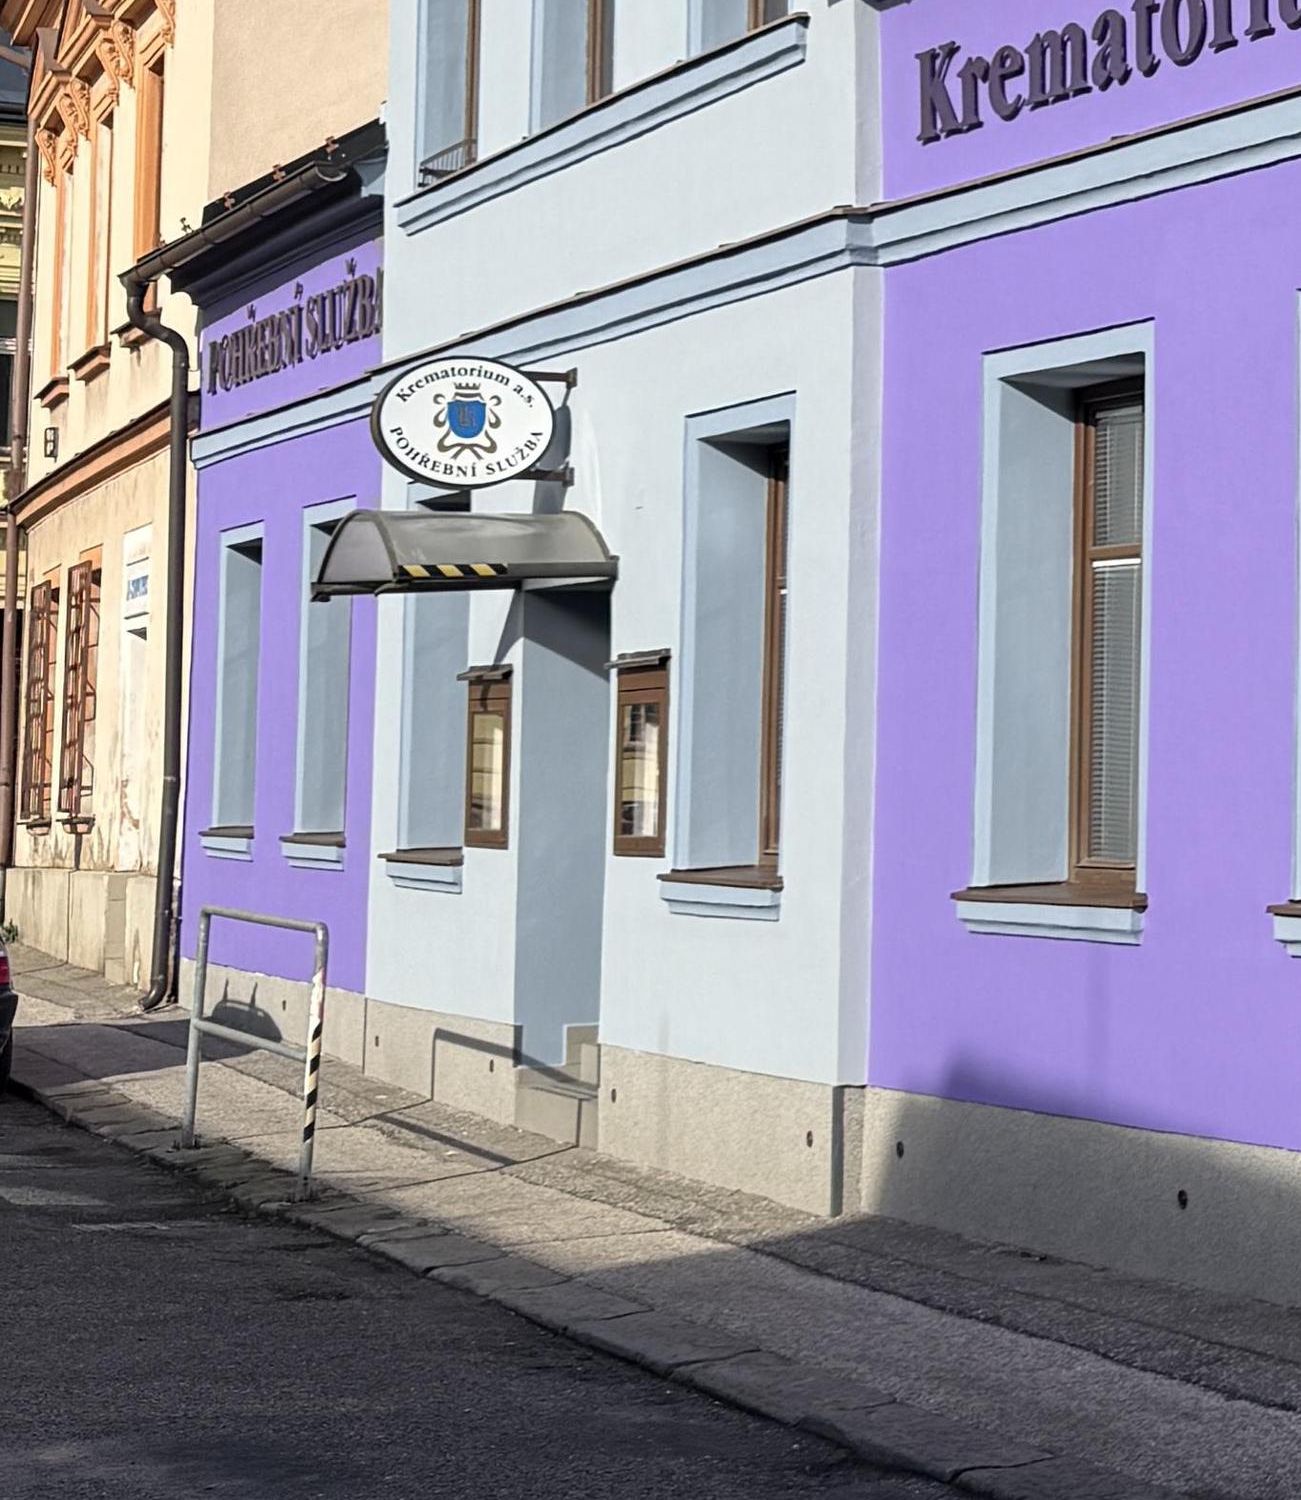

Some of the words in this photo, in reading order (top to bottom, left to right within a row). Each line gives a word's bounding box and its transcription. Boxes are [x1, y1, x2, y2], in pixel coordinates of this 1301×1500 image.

[395, 365, 511, 403] Krematorium
[512, 384, 535, 408] a.s.
[389, 426, 477, 478] POHŘEBNÍ
[485, 431, 544, 476] SLUŽBA
